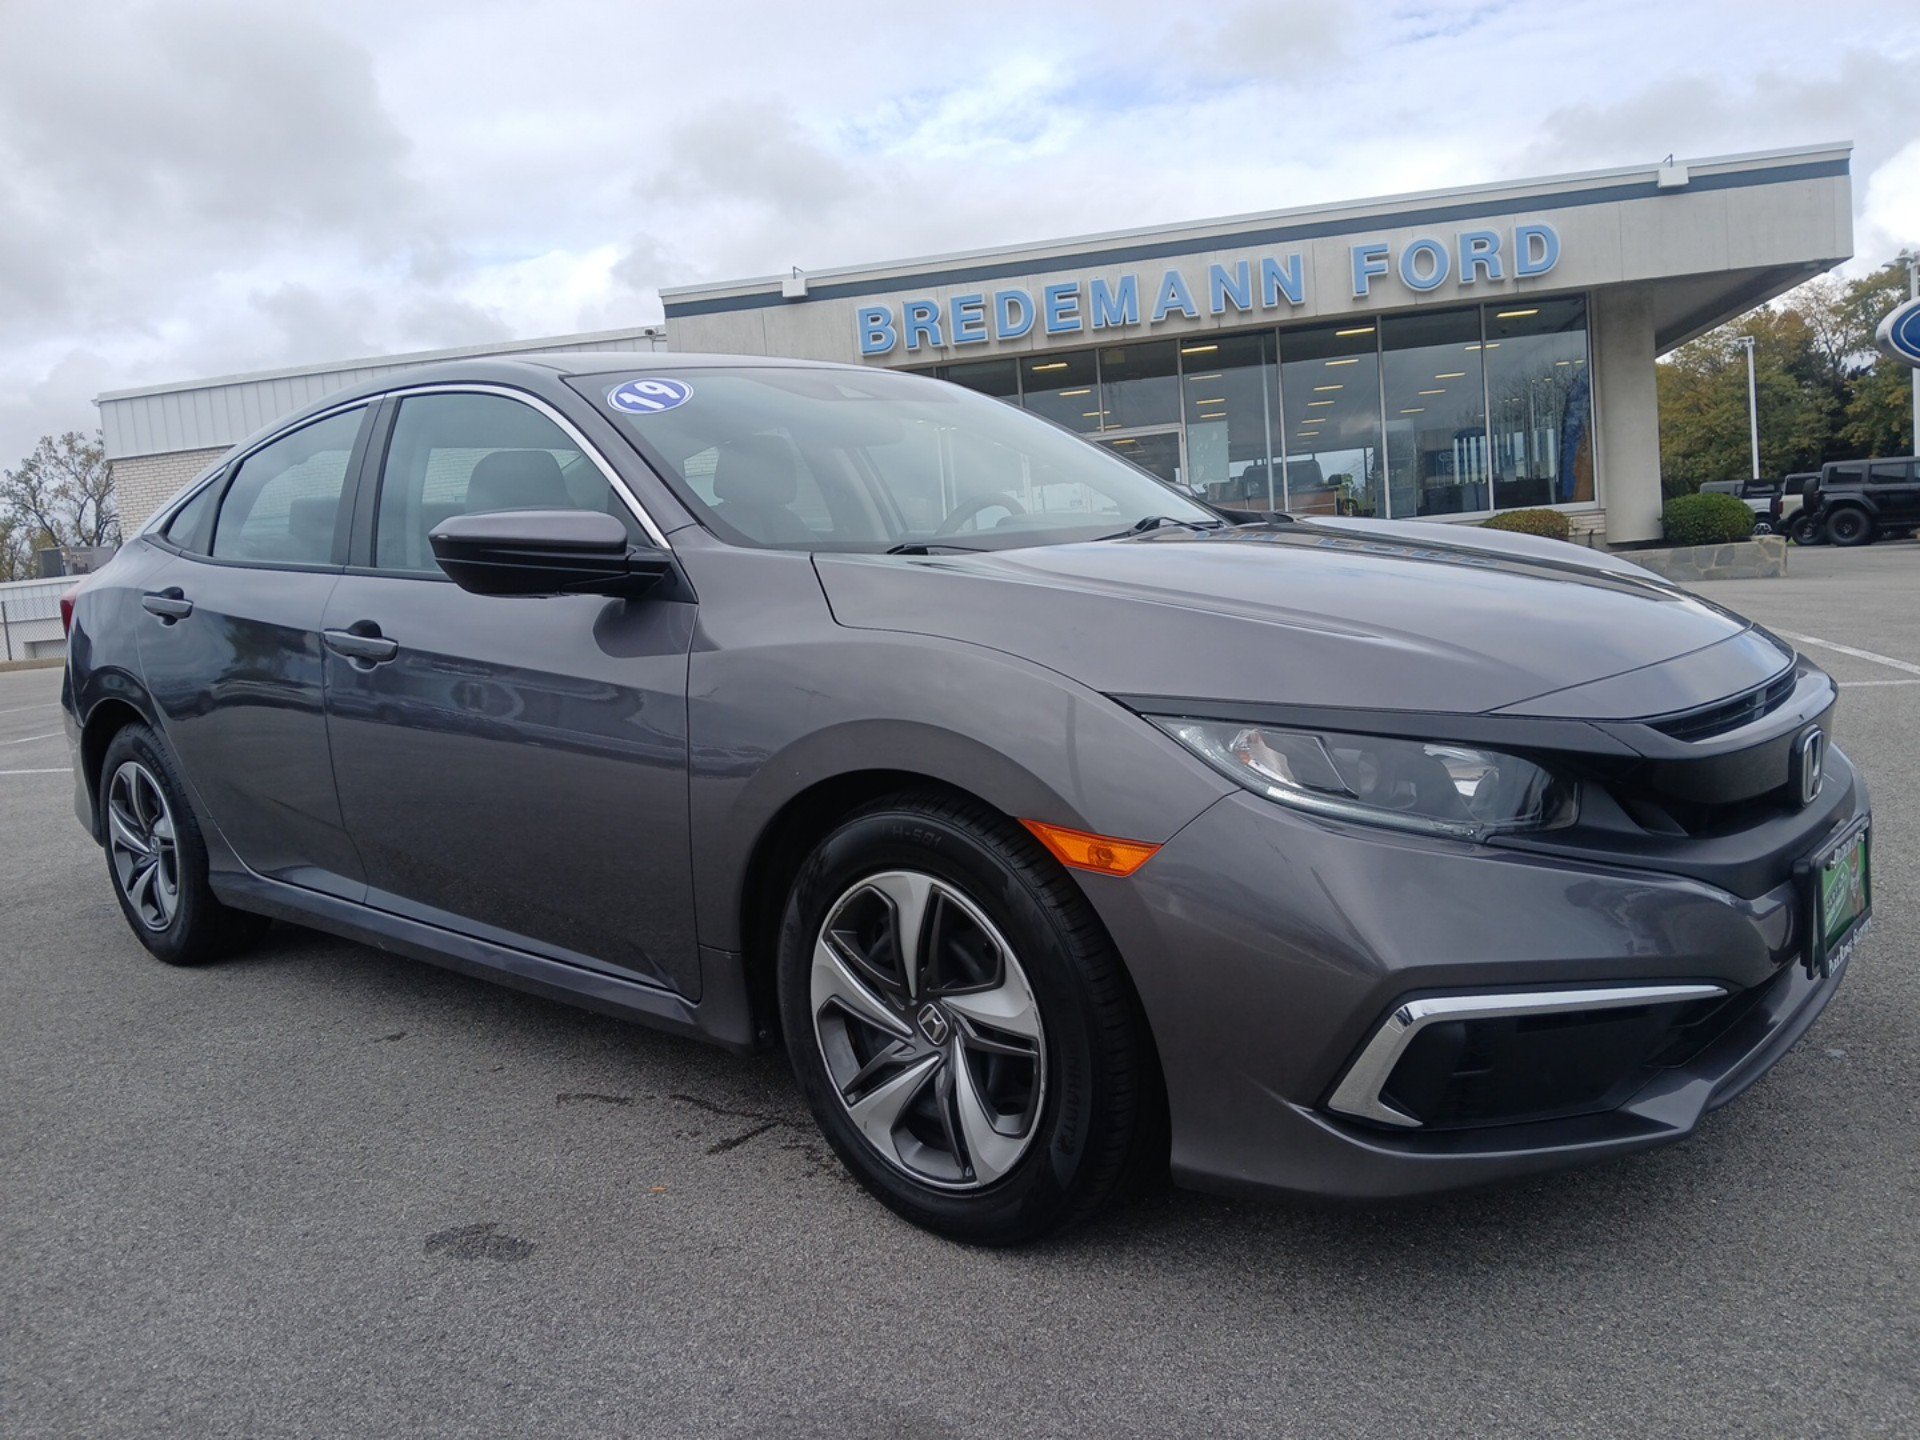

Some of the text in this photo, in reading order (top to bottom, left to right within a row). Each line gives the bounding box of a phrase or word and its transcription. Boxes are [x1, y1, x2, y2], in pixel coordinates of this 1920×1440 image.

[857, 222, 1562, 356] BREDEMANN FORD
[618, 381, 681, 409] 19
